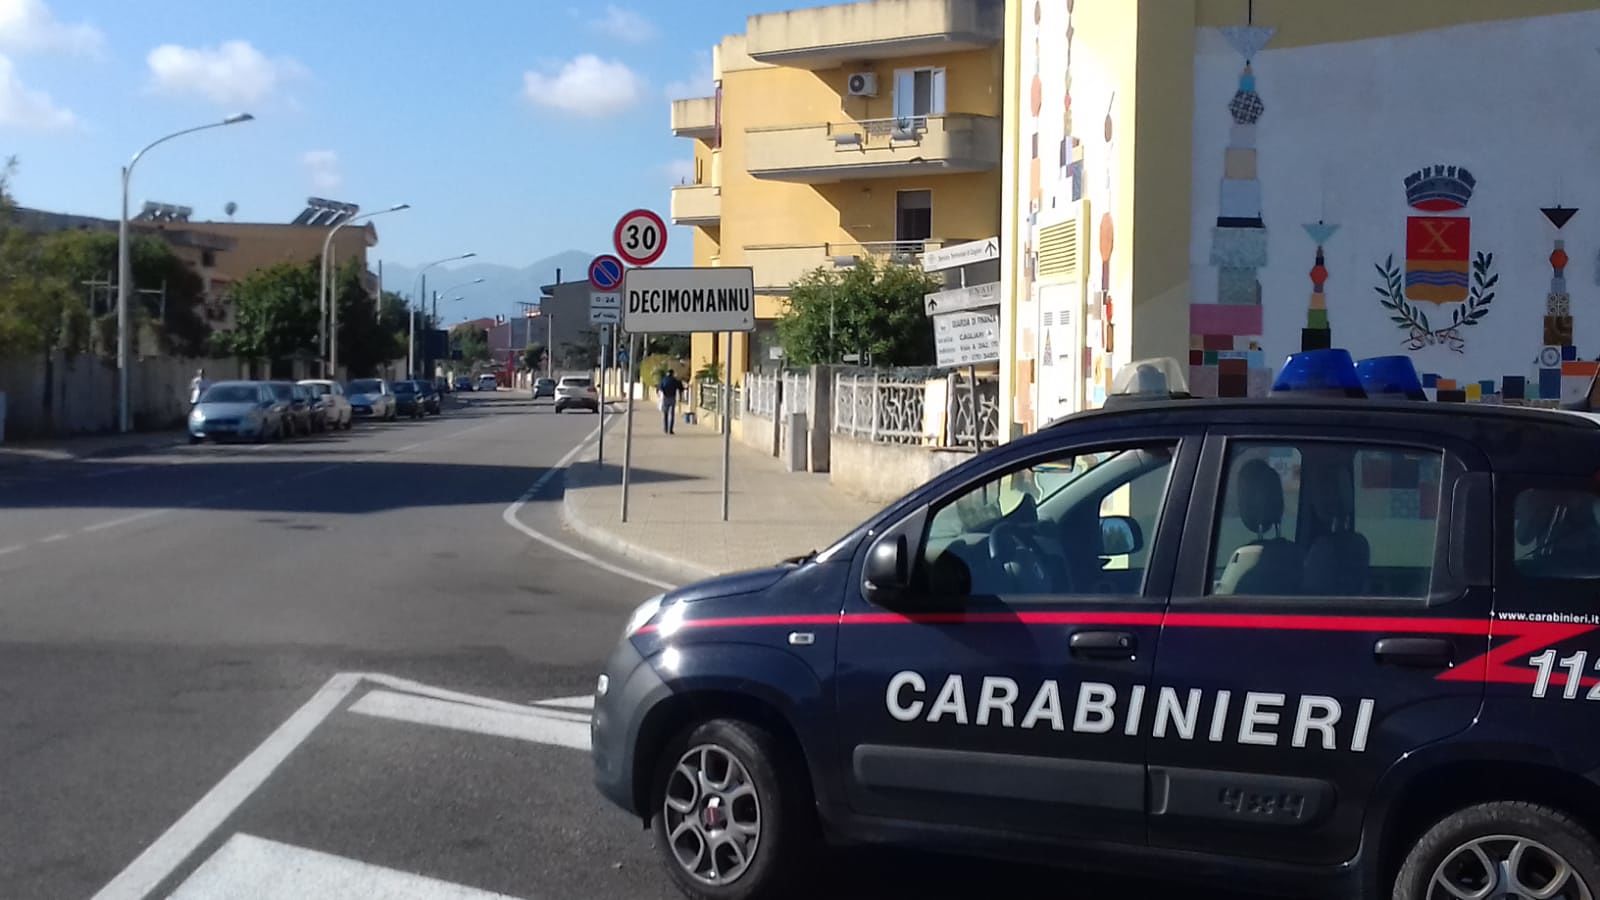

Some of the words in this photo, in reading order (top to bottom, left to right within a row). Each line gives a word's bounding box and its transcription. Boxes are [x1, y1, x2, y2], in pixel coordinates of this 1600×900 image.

[626, 224, 657, 250] 30
[1417, 221, 1457, 253] X
[629, 288, 749, 314] DECIMOMANNU
[1498, 611, 1600, 624] www.carabinieri.it
[886, 670, 1376, 753] CARABINIERI
